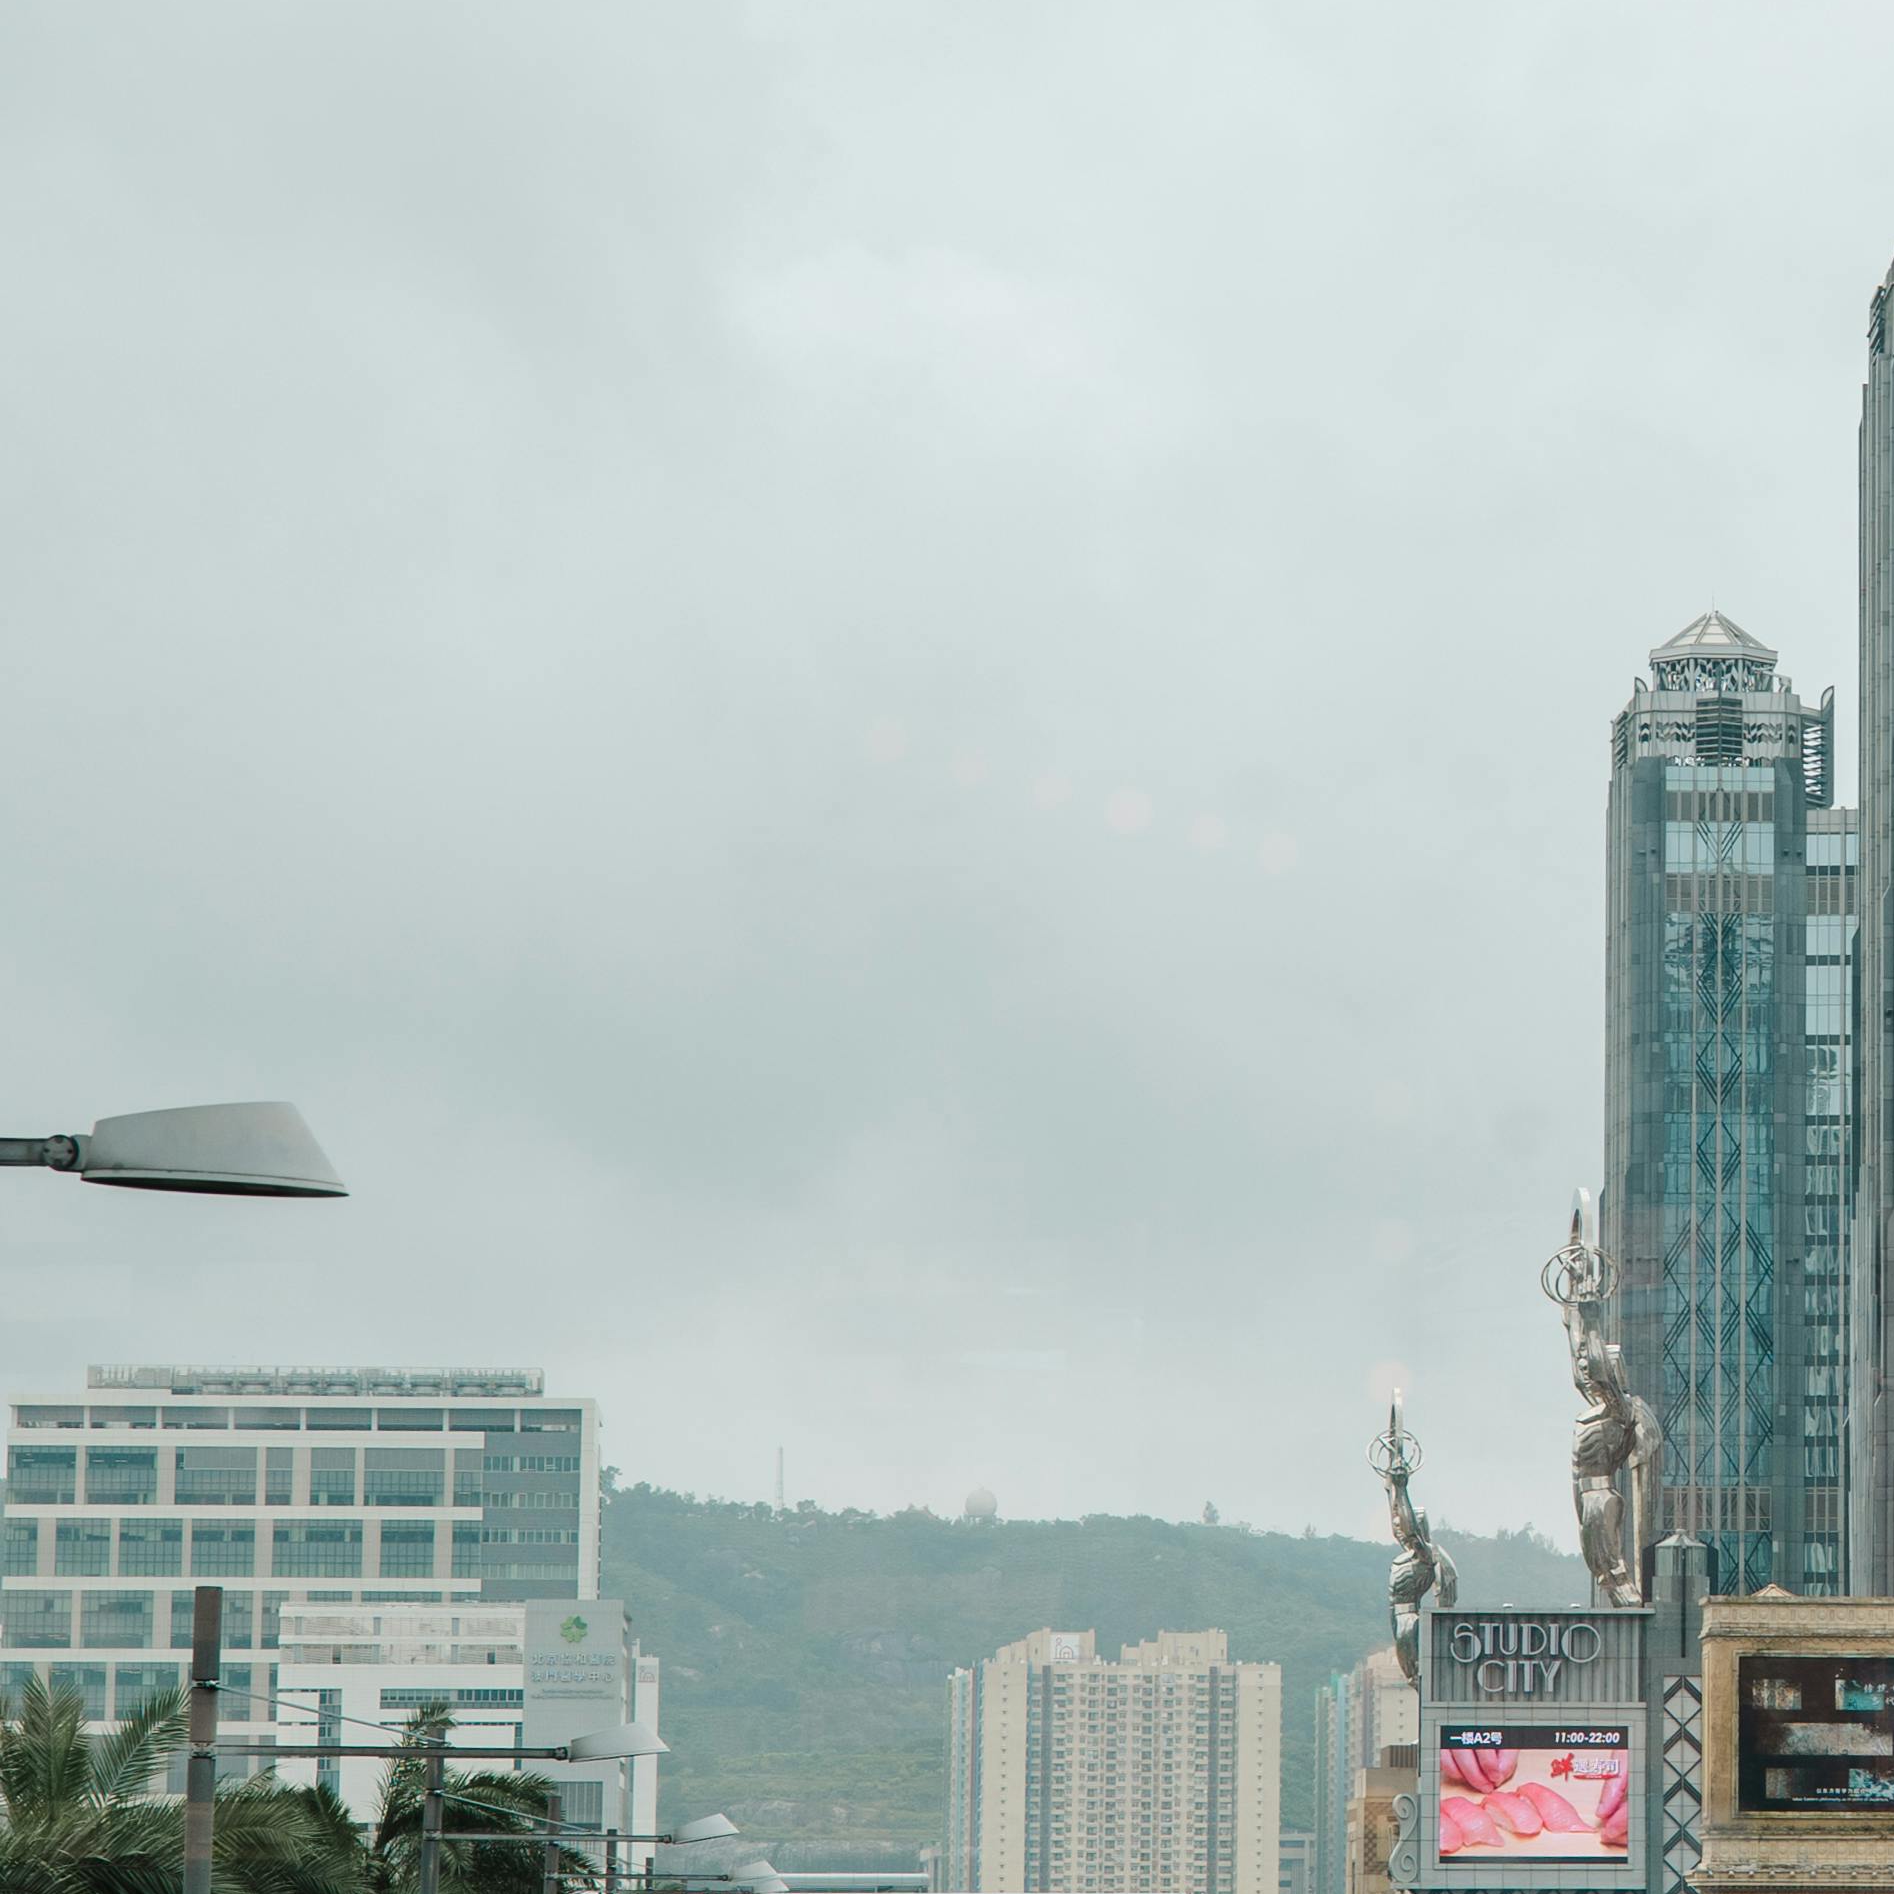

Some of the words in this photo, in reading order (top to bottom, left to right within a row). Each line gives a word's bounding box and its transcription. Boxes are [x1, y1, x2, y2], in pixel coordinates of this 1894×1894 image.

[1450, 1622, 1601, 1663] STUDIO
[1477, 1660, 1562, 1693] CITY
[1554, 1731, 1621, 1744] 11:00-22:00
